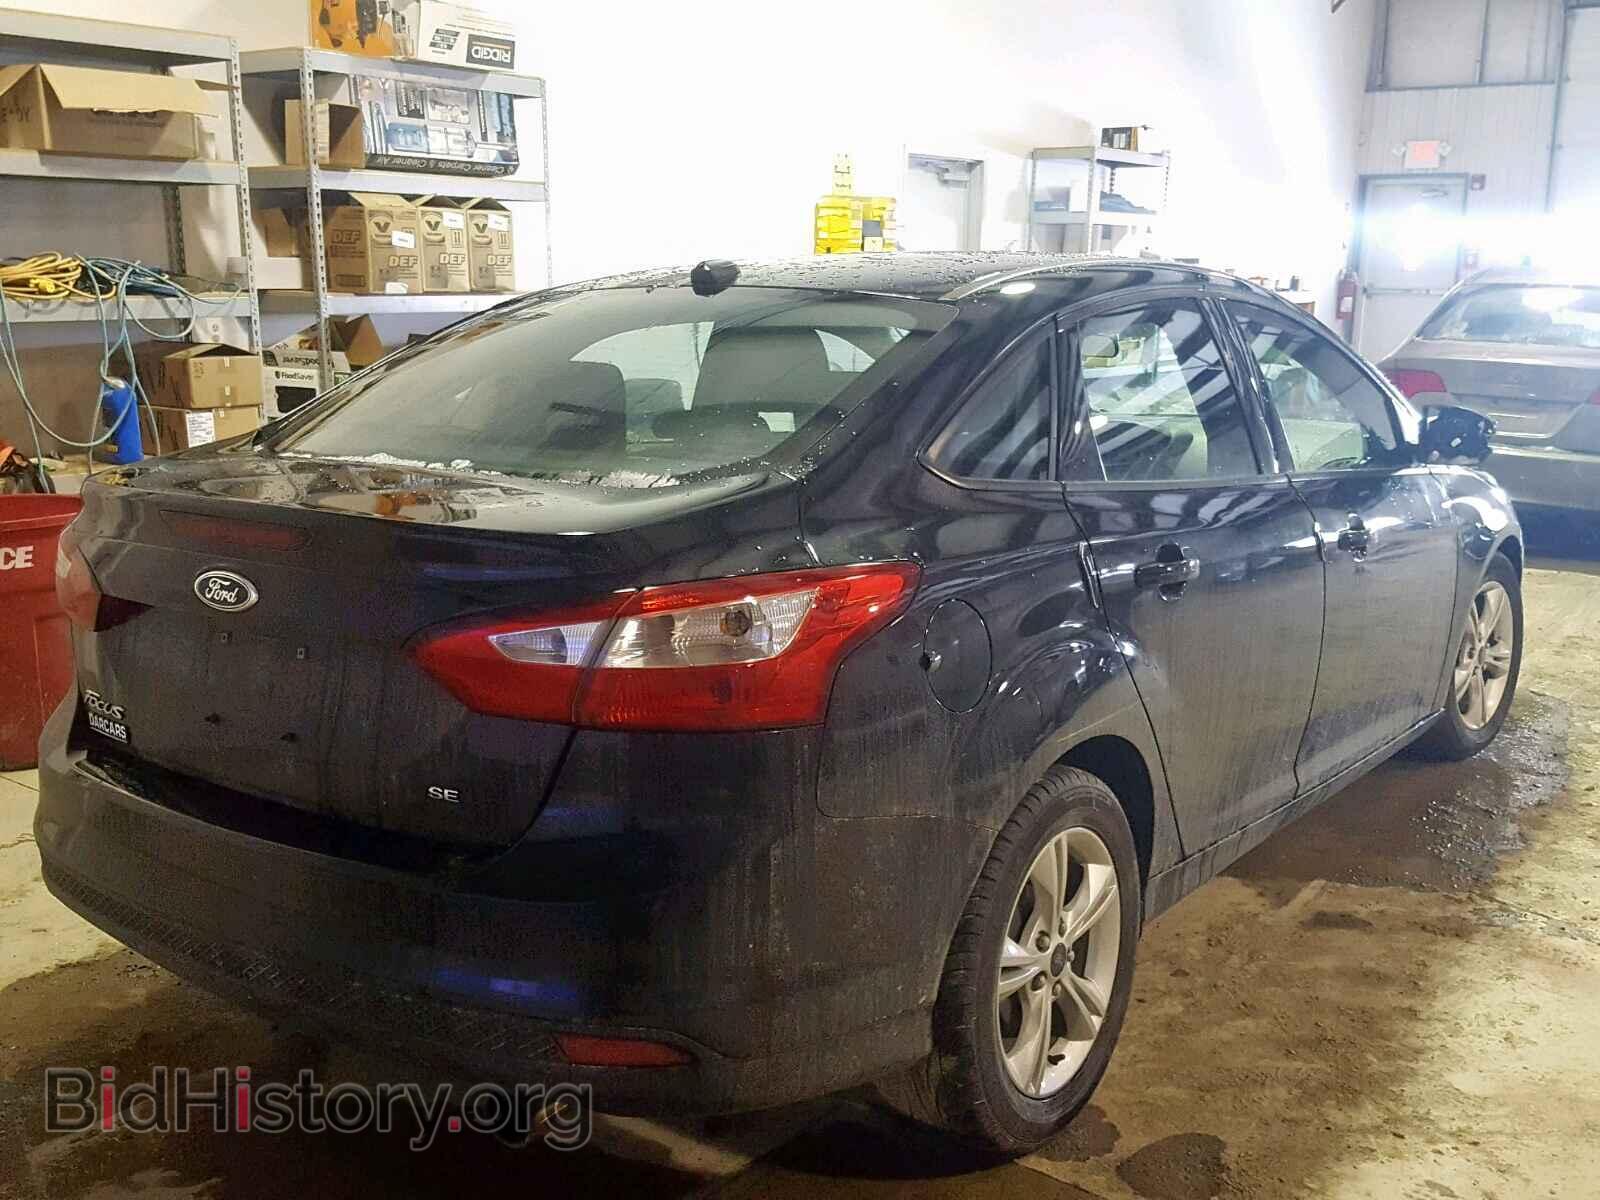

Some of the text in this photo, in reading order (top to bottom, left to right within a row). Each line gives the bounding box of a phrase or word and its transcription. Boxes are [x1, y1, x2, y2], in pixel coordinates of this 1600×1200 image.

[471, 46, 512, 64] RIDGID
[391, 157, 426, 168] Cleaner
[437, 160, 471, 171] Carpets
[332, 230, 360, 245] DEF
[388, 254, 418, 268] DEF
[439, 252, 466, 266] DEF
[487, 254, 512, 267] DEF
[281, 371, 314, 380] FoodSaver
[0, 545, 34, 570] CE
[205, 577, 239, 603] Ford
[89, 712, 127, 740] DARCARS
[427, 786, 460, 803] SE
